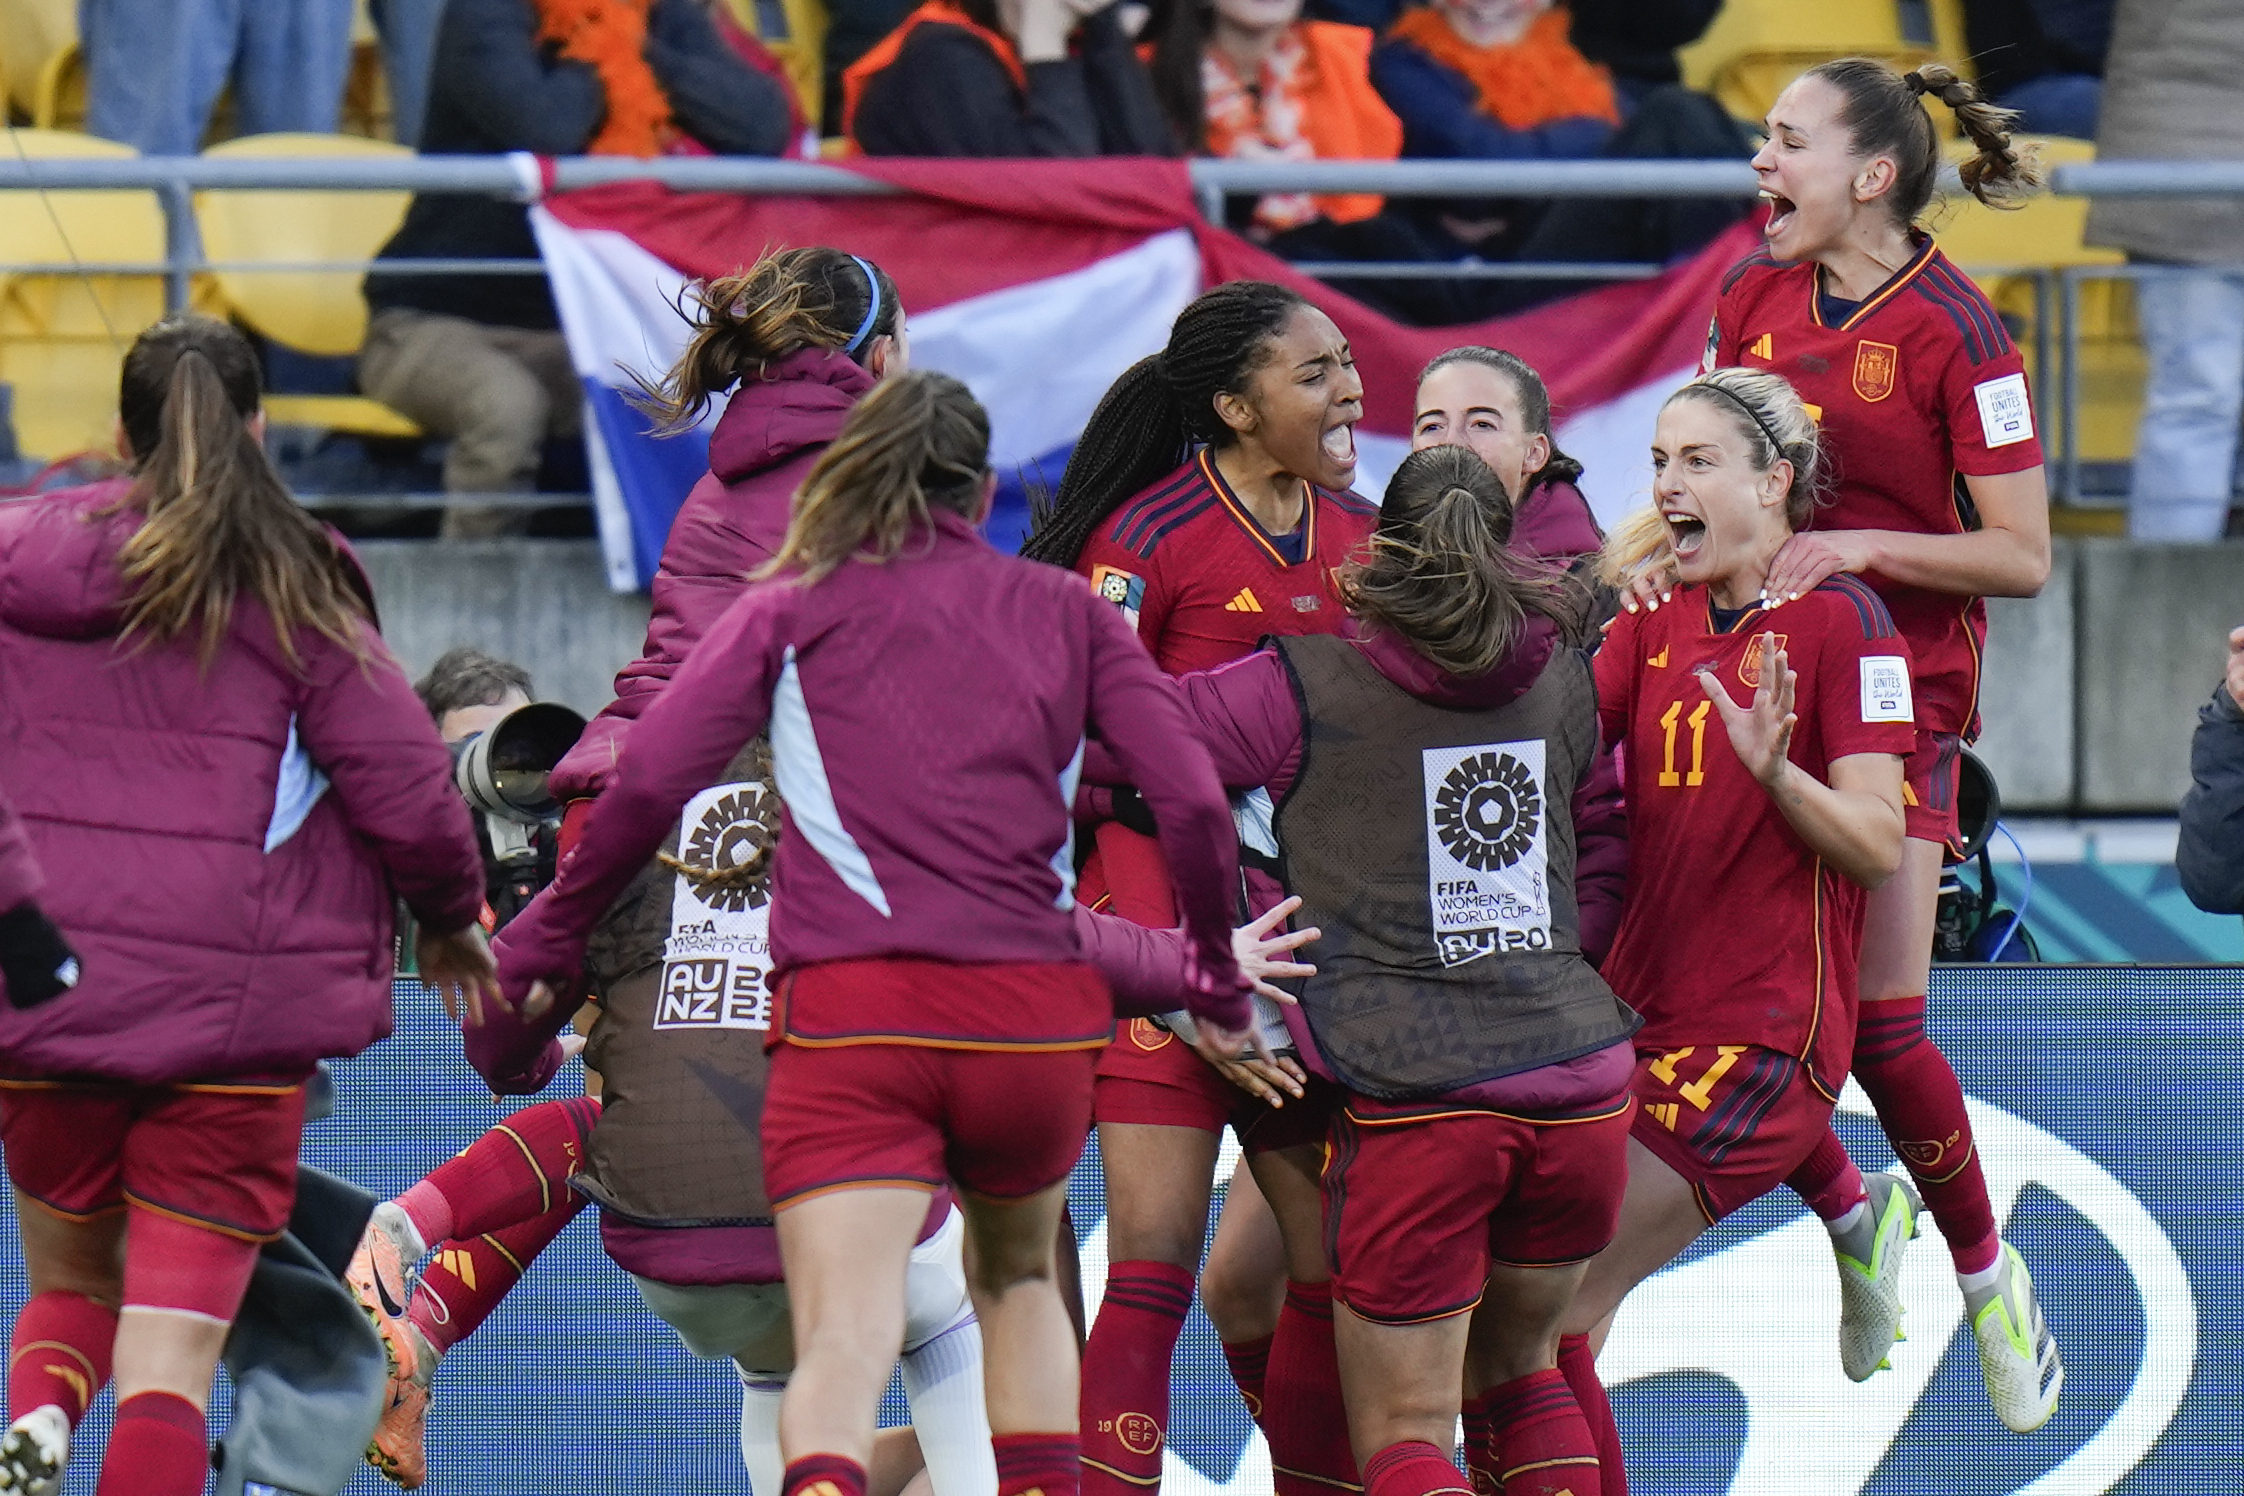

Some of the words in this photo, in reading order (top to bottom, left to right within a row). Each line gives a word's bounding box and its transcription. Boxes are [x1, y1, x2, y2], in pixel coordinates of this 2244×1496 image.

[1992, 396, 2021, 412] UNITES
[1873, 677, 1901, 689] UNITES
[1658, 700, 1712, 787] 11
[1437, 880, 1478, 896] FIFA
[1438, 892, 1517, 910] WOMEN'S
[1440, 908, 1499, 925] WORLD
[1501, 905, 1532, 919] CUP
[667, 963, 724, 992] AU
[663, 992, 720, 1021] NZ
[1097, 1420, 1112, 1433] 19
